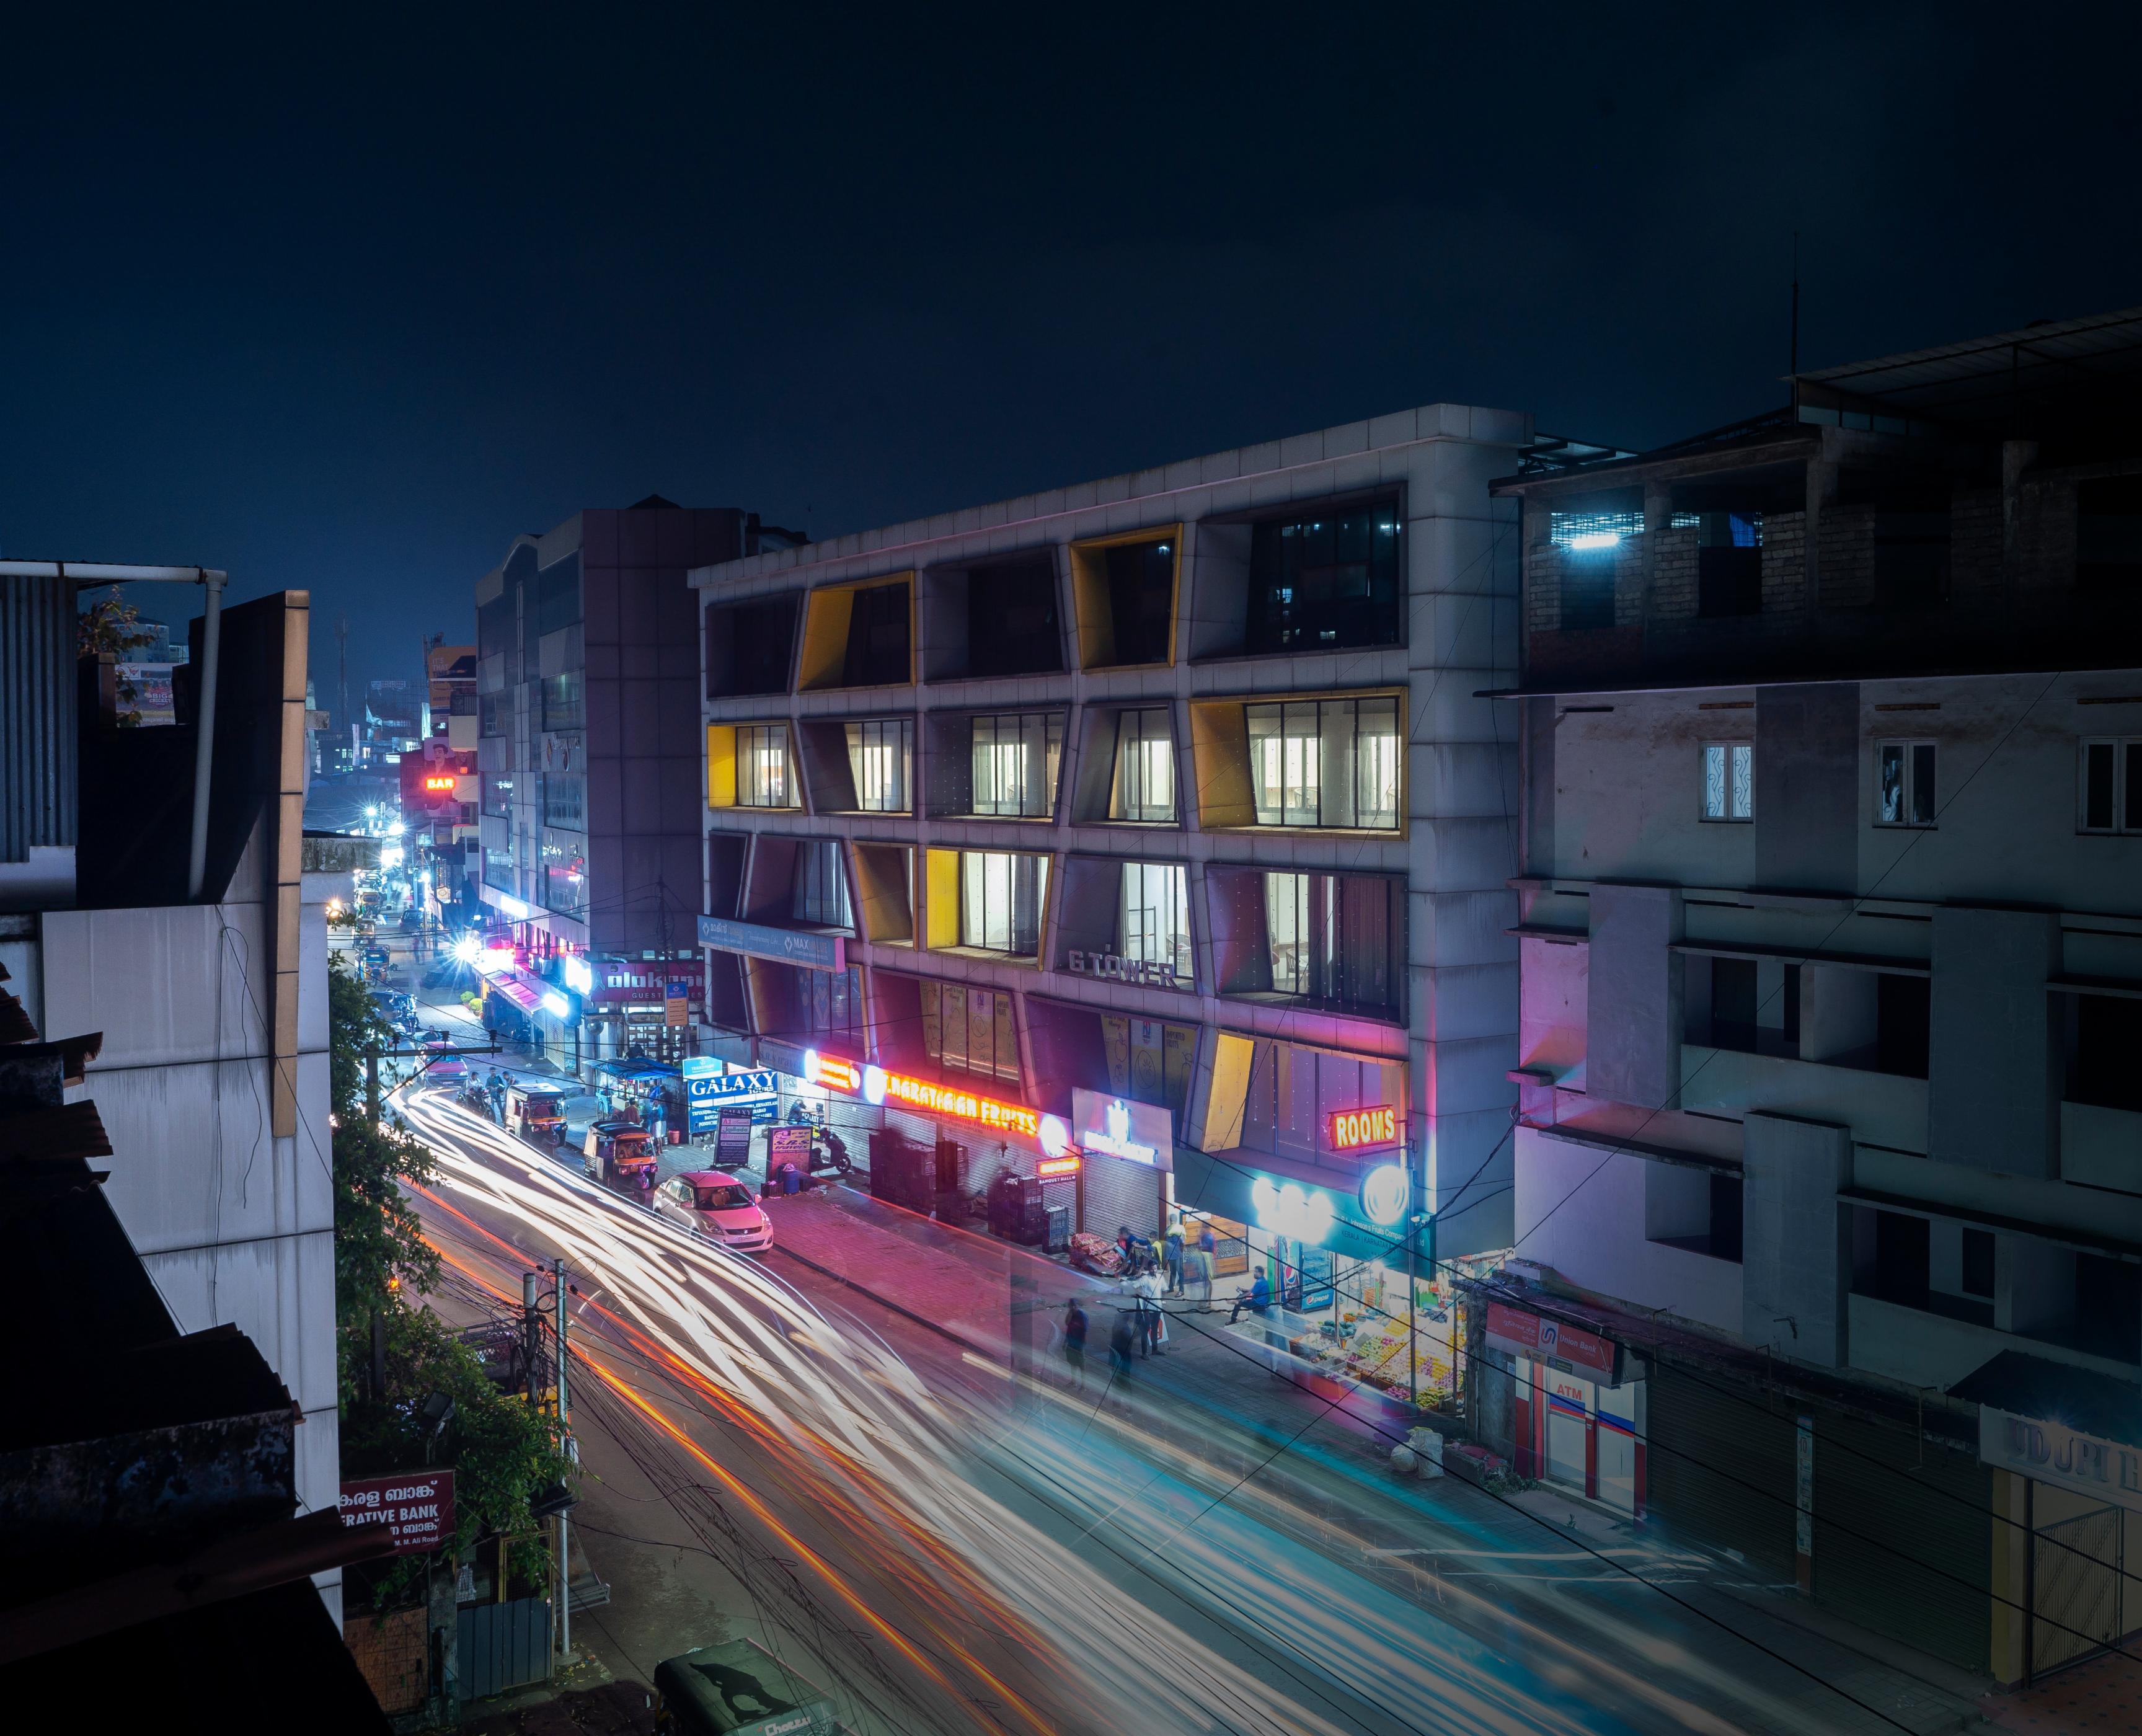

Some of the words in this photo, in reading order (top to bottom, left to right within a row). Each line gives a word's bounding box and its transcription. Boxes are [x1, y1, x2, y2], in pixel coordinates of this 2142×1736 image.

[427, 778, 454, 790] BAR
[794, 937, 808, 950] MAX
[1069, 949, 1084, 973] G
[1088, 952, 1180, 989] TOWER
[1166, 1030, 1185, 1042] IMPORTED
[1166, 1040, 1179, 1049] FRUITS
[691, 1071, 777, 1096] GALAXY
[748, 1086, 774, 1095] TOURS
[981, 1100, 1038, 1137] FRUITS
[1336, 1109, 1395, 1147] ROOMS
[1038, 1177, 1060, 1185] BANQUET
[1341, 1230, 1360, 1241] KERALA
[1371, 1224, 1384, 1235] Fruits
[1385, 1229, 1407, 1241] Company
[1313, 1294, 1329, 1304] pepsi
[1559, 1334, 1578, 1346] Union
[1580, 1340, 1597, 1354] Bank
[1557, 1383, 1582, 1401] ATM
[2006, 1417, 2110, 1482] UDUPI
[400, 1504, 438, 1521] BANK
[422, 1534, 439, 1543] Road
